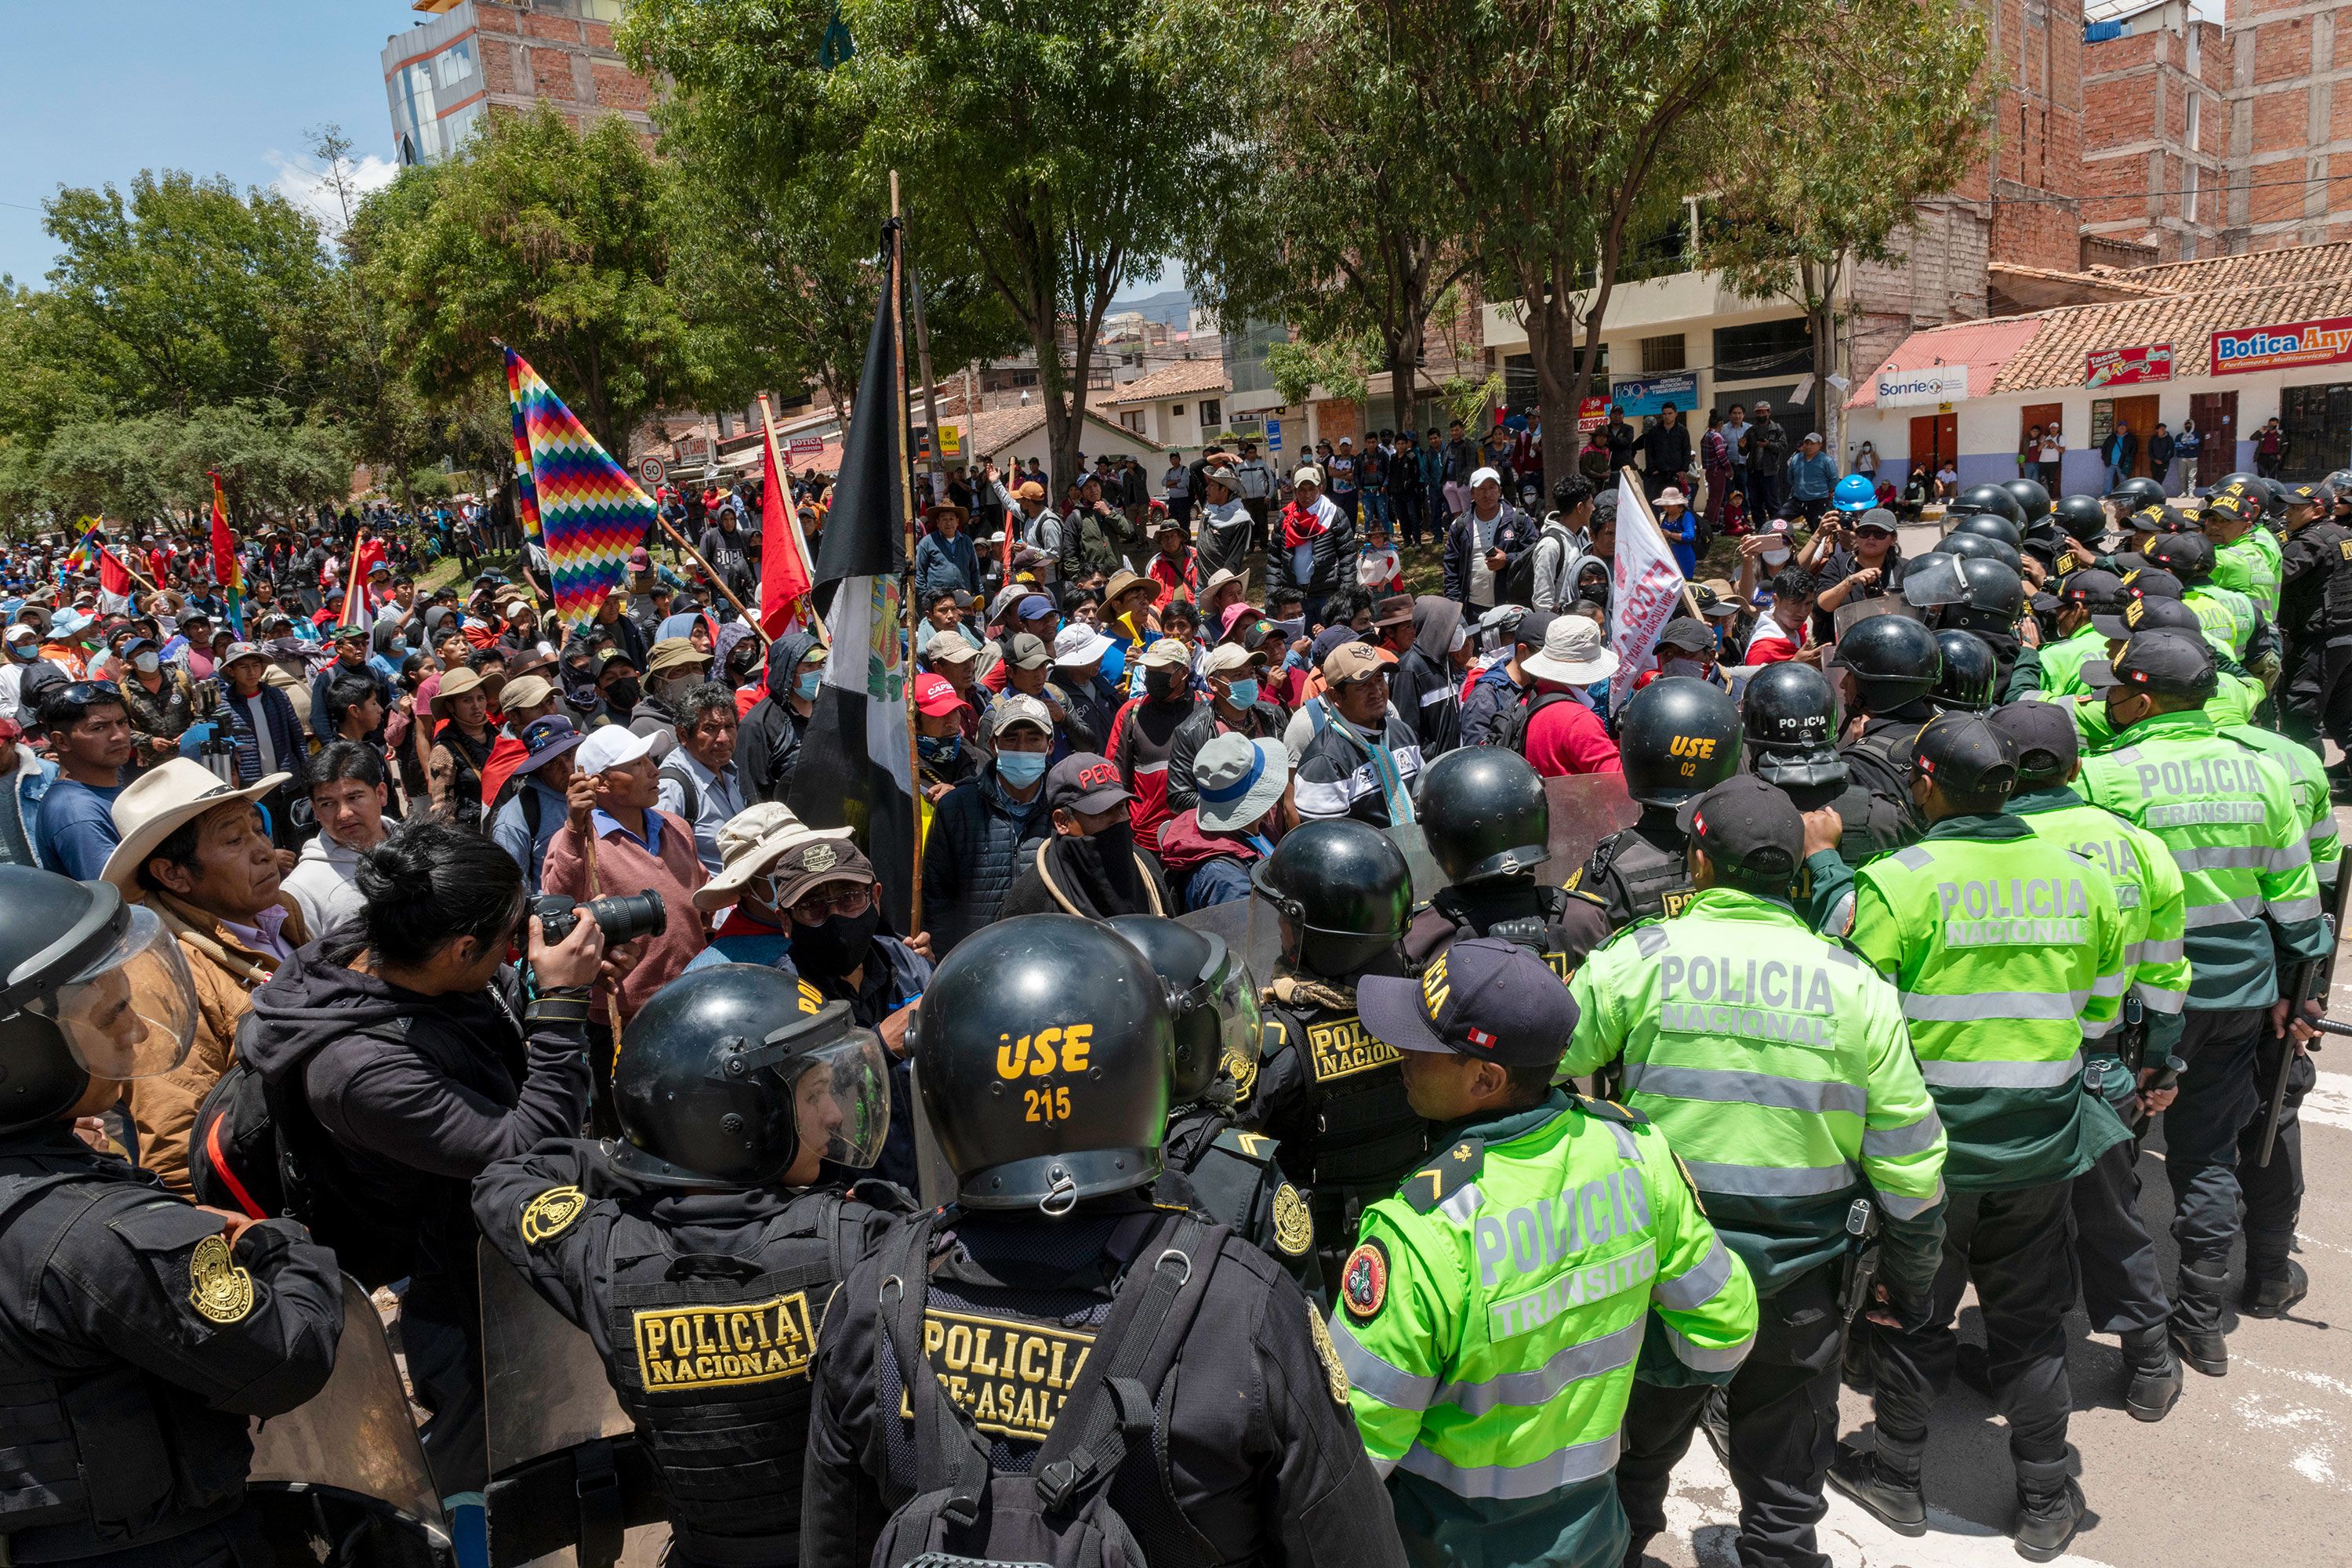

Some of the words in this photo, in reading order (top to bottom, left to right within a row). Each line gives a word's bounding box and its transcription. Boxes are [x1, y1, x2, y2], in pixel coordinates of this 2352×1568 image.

[2089, 351, 2121, 365] Tacos
[2219, 333, 2298, 359] Botica
[2272, 352, 2332, 364] Multiservicios
[1879, 379, 1926, 396] Sonríe
[682, 442, 689, 455] EL
[645, 466, 659, 475] 50
[1671, 735, 1716, 759] USE
[1681, 762, 1697, 777] 02
[2136, 760, 2266, 798] POLICIA
[2151, 802, 2264, 824] TRANSITO
[808, 855, 829, 864] ARMY
[1937, 878, 2088, 920] POLICIA
[1947, 920, 2085, 946] NACIONAL
[1661, 956, 1835, 1014] POLICIA
[1662, 1004, 1831, 1047] NACIONAL
[996, 1024, 1093, 1080] USE
[1024, 1087, 1071, 1122] 215
[1475, 1168, 1650, 1287] POLICIA
[193, 1245, 209, 1276] POLICIA
[1494, 1247, 1655, 1336] TRANSITO
[198, 1301, 241, 1319] DIVOPUS
[644, 1305, 802, 1359] POLICIA
[650, 1345, 808, 1383] NACIONAL
